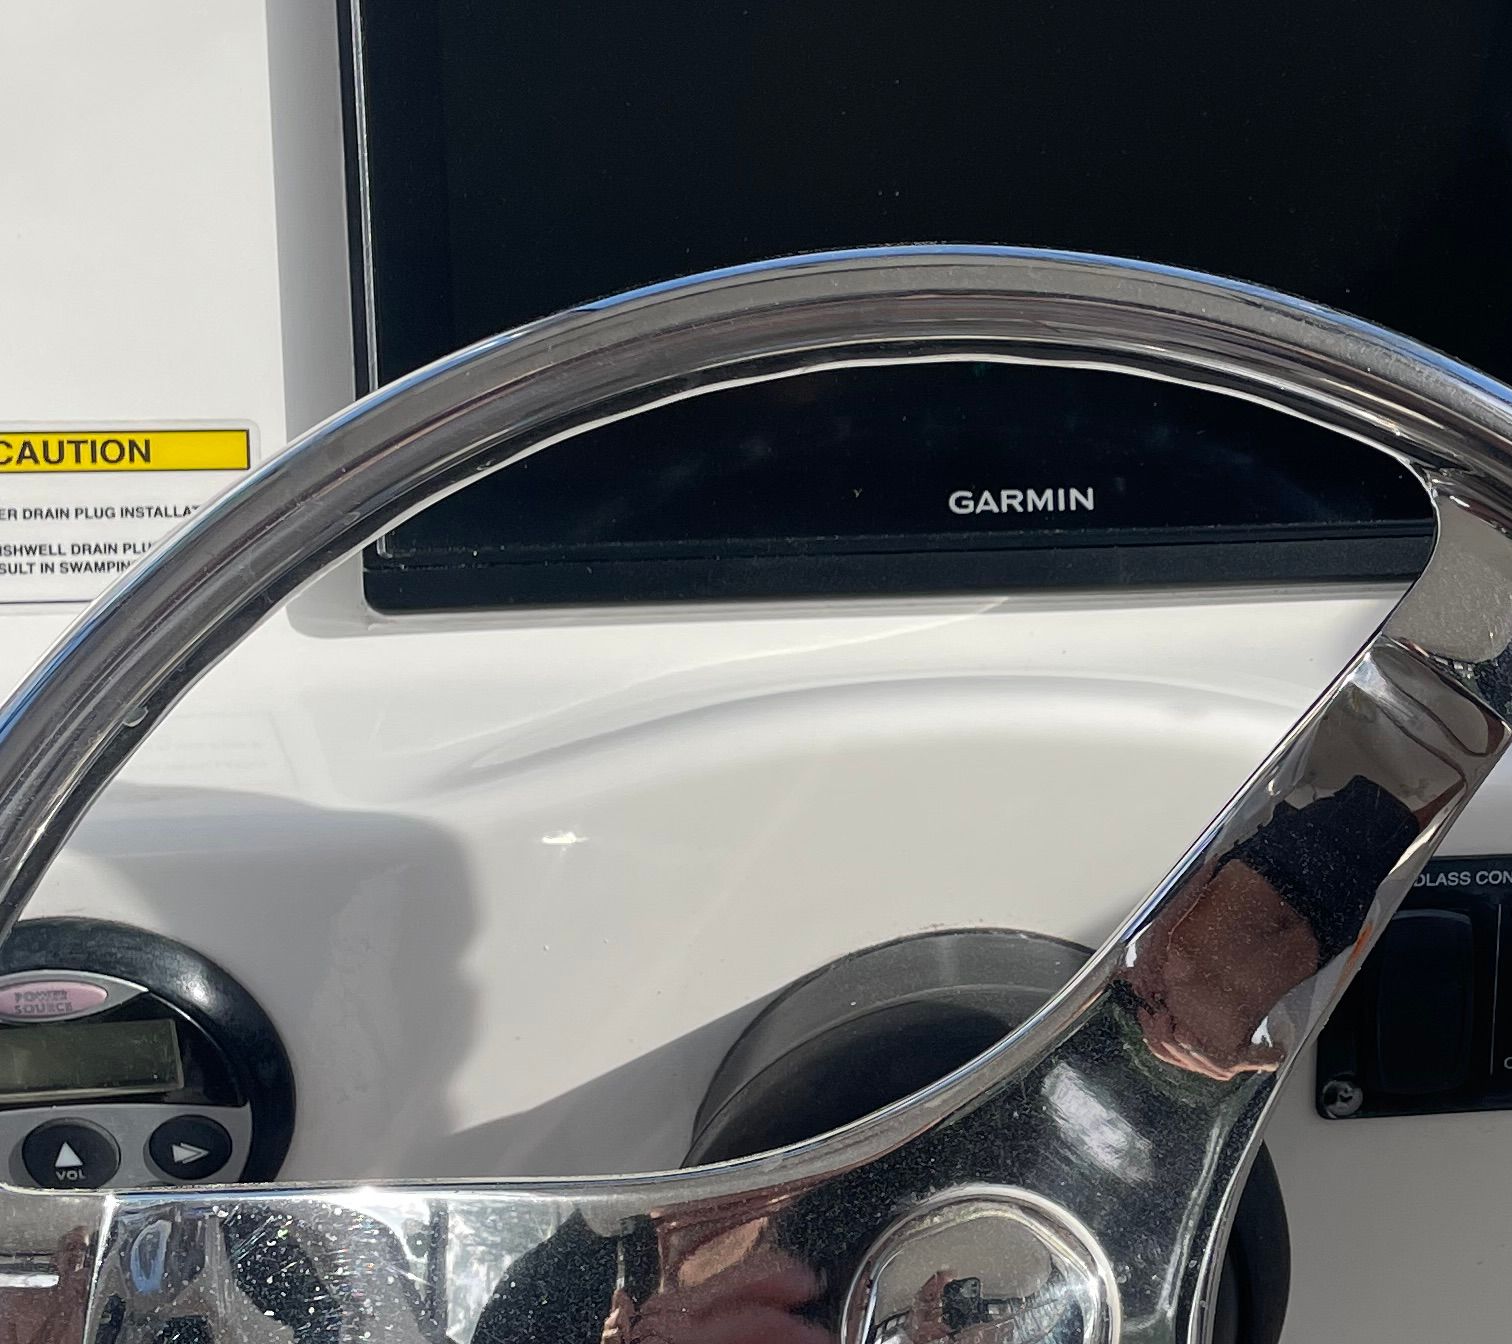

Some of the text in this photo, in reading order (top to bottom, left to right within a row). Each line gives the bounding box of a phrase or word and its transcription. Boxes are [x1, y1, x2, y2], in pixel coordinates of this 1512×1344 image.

[0, 439, 151, 465] CAUTION
[949, 487, 1094, 514] GARMIN
[22, 505, 199, 520] DRAIN PLUG INSTALLA
[71, 543, 118, 556] DRAIN
[40, 561, 55, 574] IN
[15, 989, 68, 1003] POWER
[14, 1001, 73, 1016] SOURCE
[55, 1168, 87, 1181] VOL
